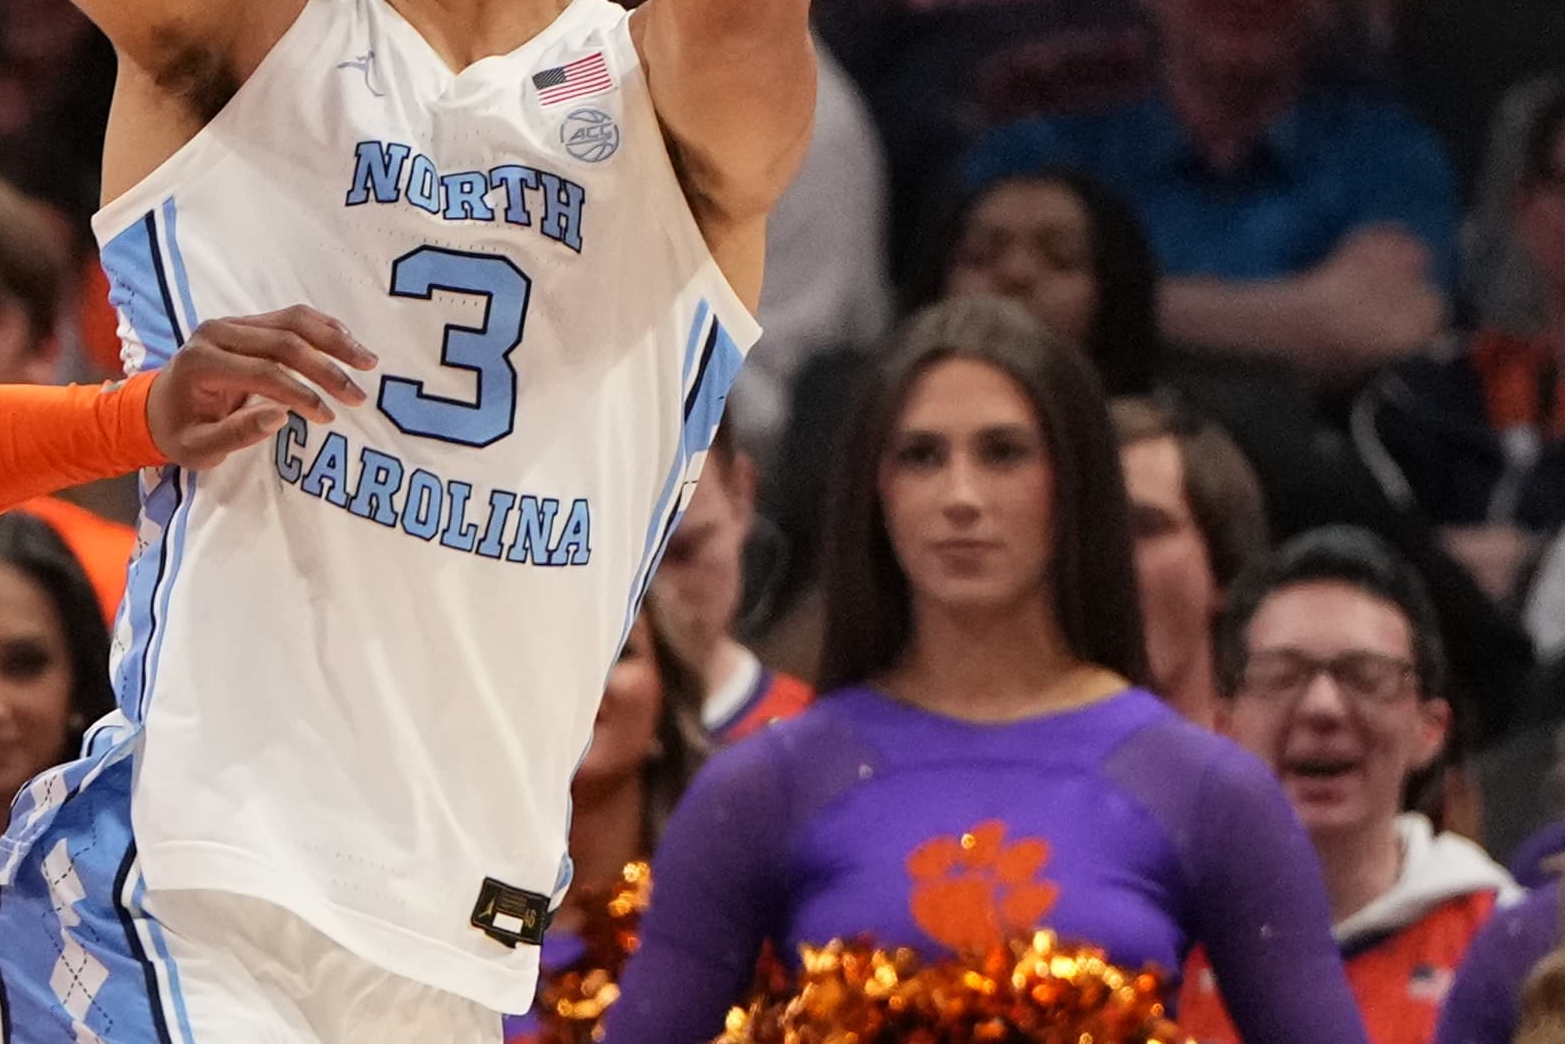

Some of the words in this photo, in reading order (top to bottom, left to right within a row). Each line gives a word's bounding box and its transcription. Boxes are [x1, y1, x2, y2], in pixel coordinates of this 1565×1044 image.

[345, 140, 585, 254] NORTH
[568, 122, 613, 143] ACC
[377, 244, 531, 448] 3
[274, 411, 592, 566] CAROLINA
